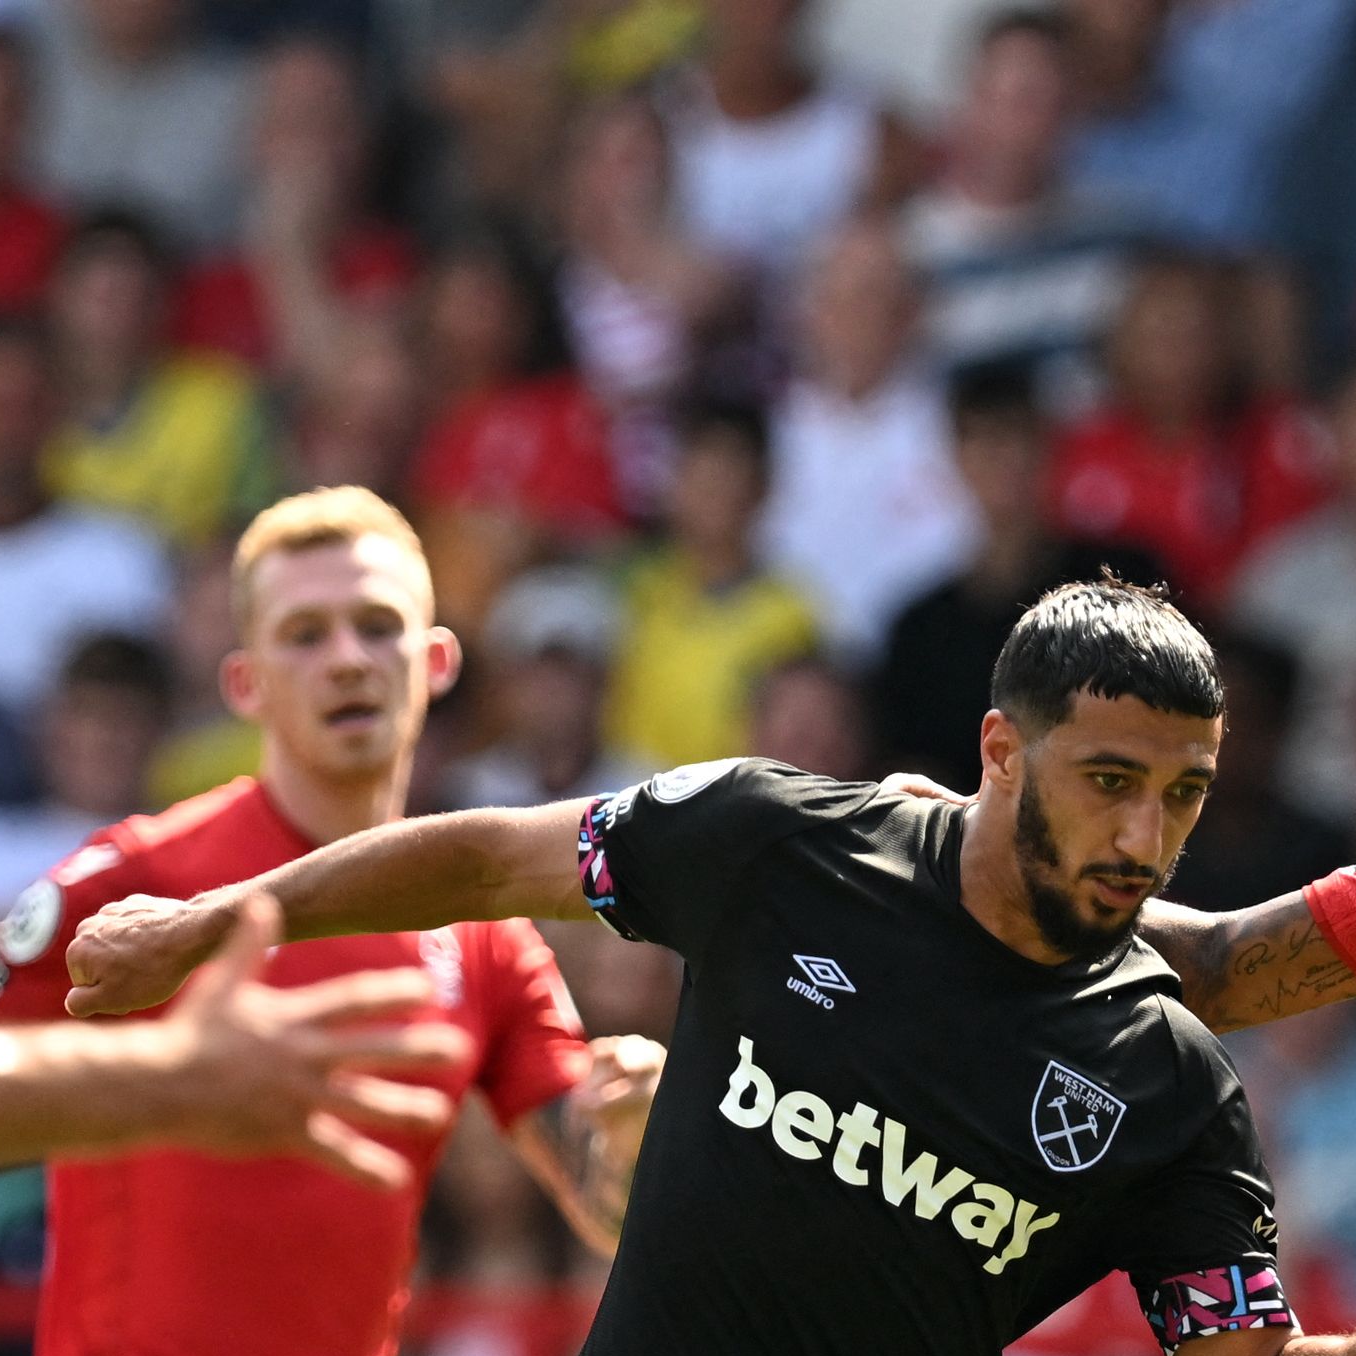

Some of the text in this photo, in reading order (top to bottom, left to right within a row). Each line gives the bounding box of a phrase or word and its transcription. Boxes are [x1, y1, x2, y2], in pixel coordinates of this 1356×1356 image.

[786, 976, 835, 1010] umbro
[1054, 1069, 1116, 1115] WEST HAM
[1063, 1085, 1099, 1114] UNITED
[718, 1035, 1061, 1276] betway
